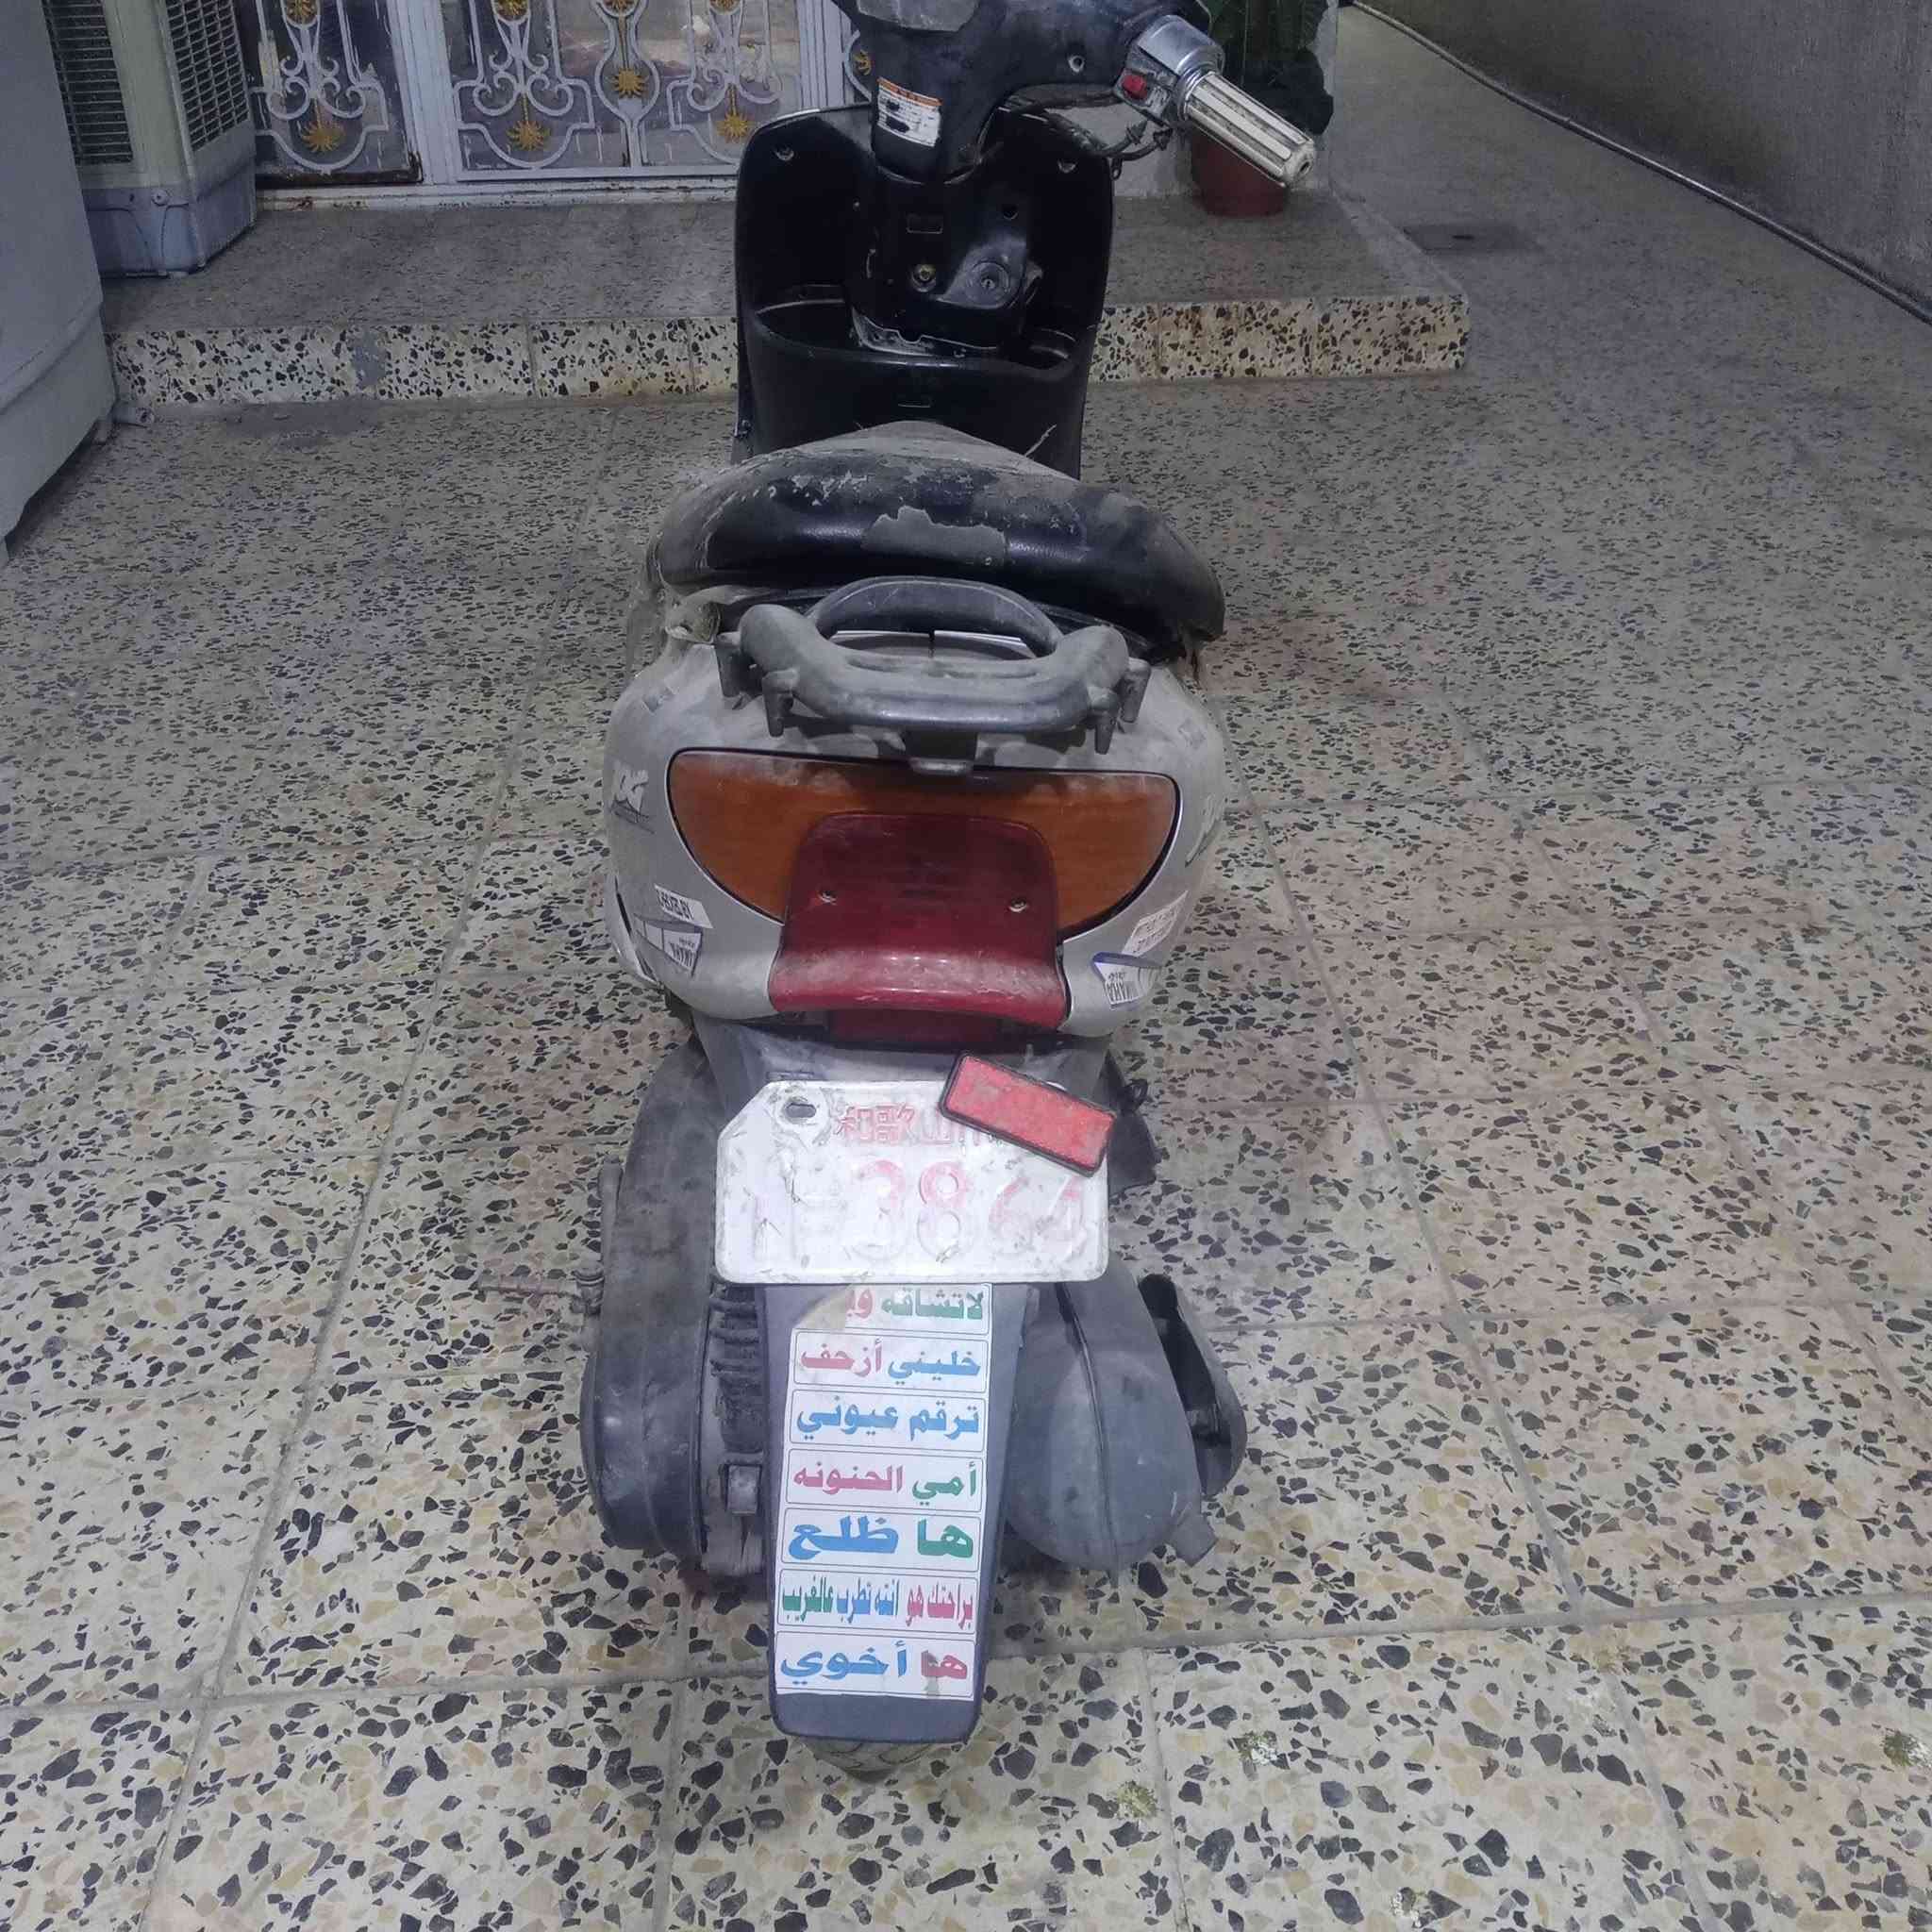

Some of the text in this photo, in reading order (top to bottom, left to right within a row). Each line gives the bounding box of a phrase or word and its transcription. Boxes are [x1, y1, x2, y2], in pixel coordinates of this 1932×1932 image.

[801, 1338, 980, 1385] خليني أزحف
[796, 1395, 979, 1441] ترقم عيوني
[793, 1461, 976, 1507] أمي الحنونه
[789, 1515, 974, 1560] ها ظلع
[780, 1640, 968, 1686] ها أخوي
